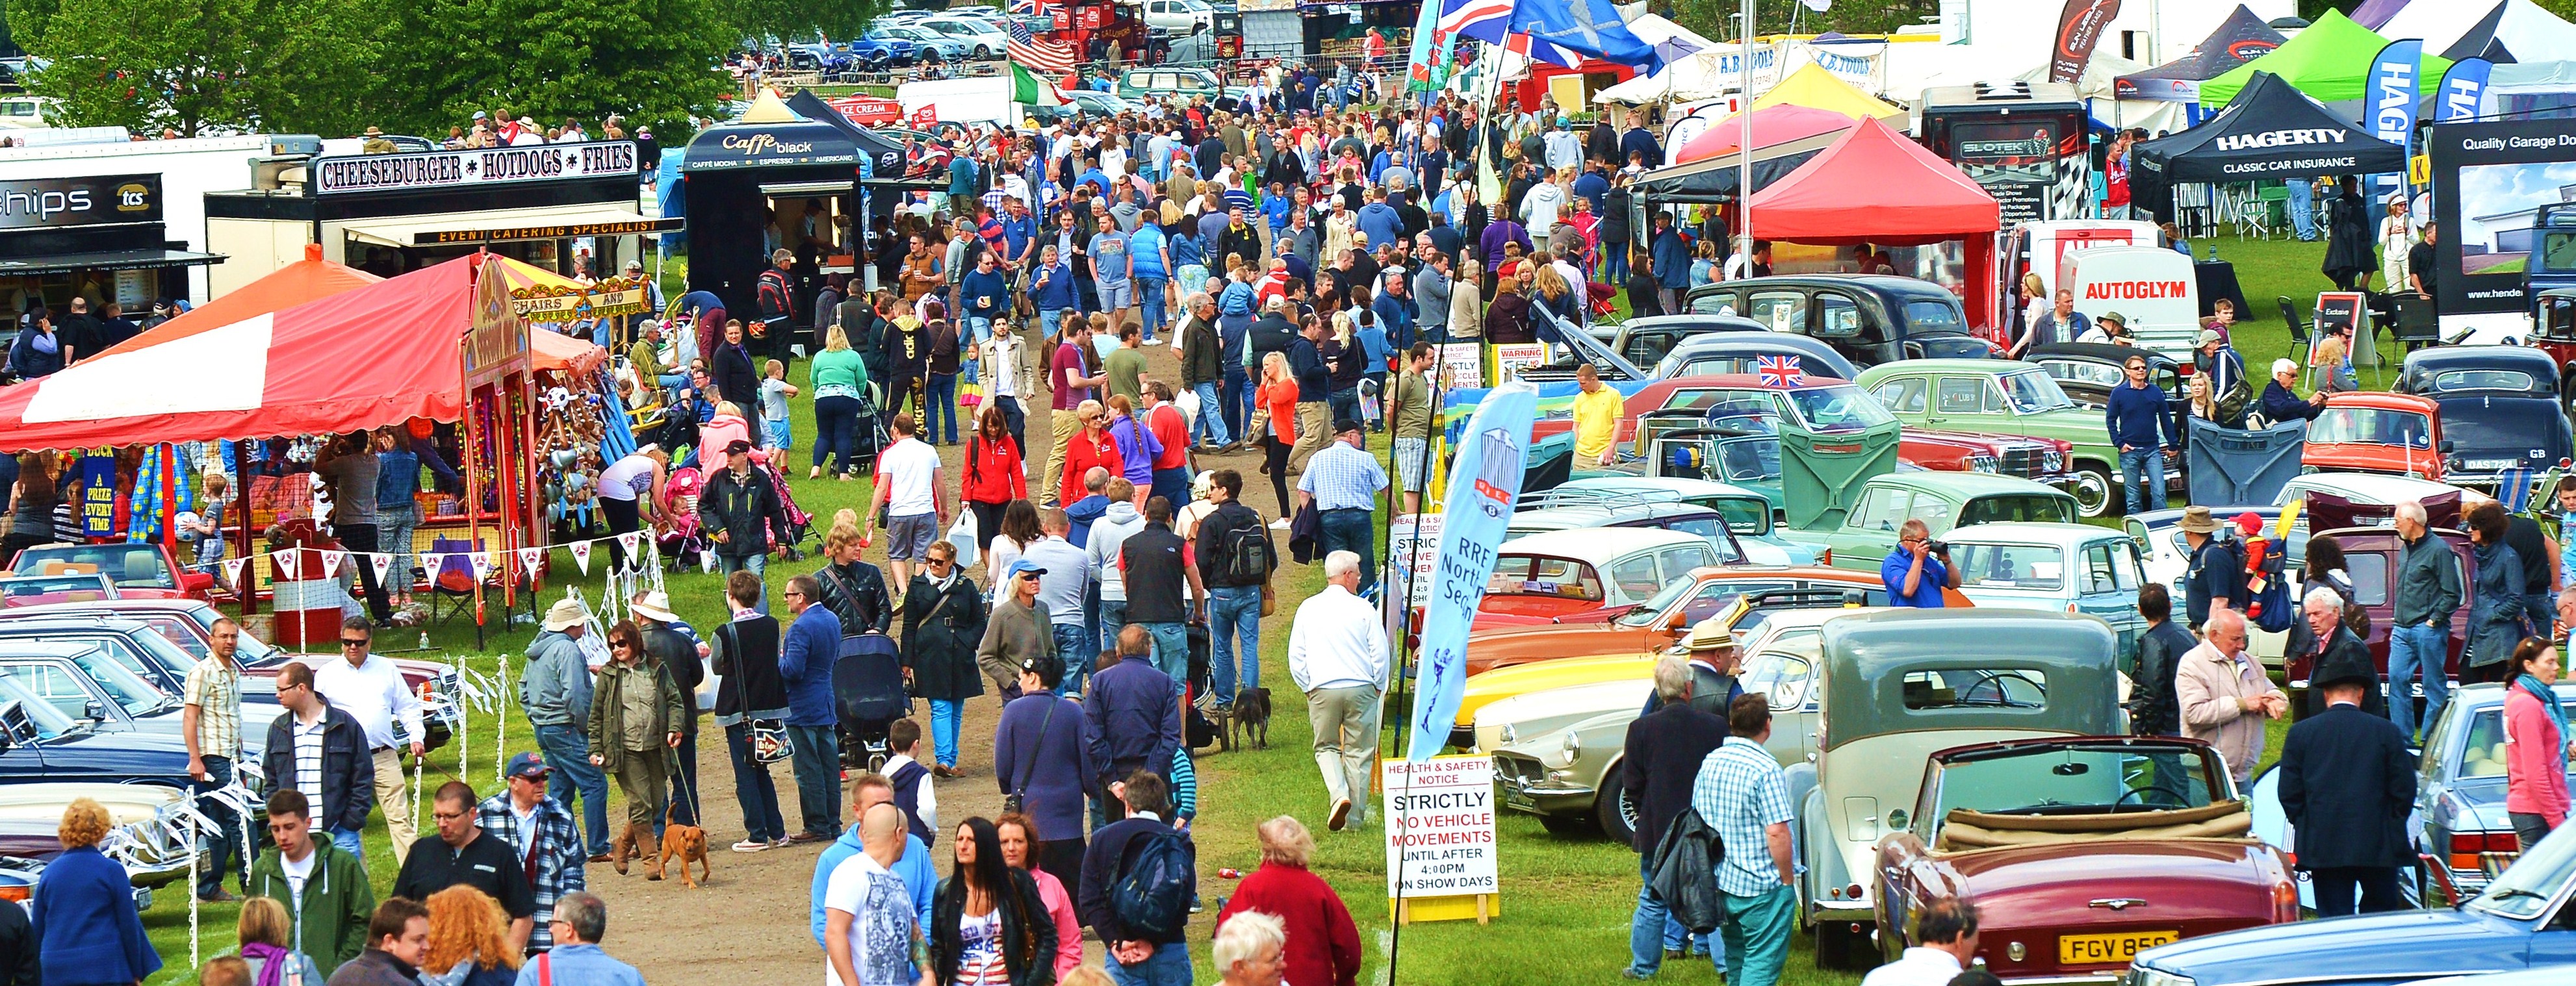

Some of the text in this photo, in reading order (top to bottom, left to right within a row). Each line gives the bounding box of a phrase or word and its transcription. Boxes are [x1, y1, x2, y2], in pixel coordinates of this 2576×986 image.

[2080, 0, 2104, 31] LEISUR
[840, 104, 886, 114] ICE CREAM
[777, 141, 812, 153] black
[2216, 129, 2347, 151] HAGERTY
[2462, 137, 2506, 151] Quality
[2509, 135, 2557, 151] Garage
[1964, 142, 2024, 153] SLOTEK
[321, 144, 633, 189] CHEESEBURGER HOTDOGS FRIES
[2223, 157, 2356, 173] CLASSIC CAR INSURANCE
[2415, 158, 2425, 181] K
[0, 189, 92, 220] hips
[122, 190, 144, 207] tcs
[440, 220, 656, 242] EVENT CATERING SPECIALIST
[2085, 281, 2186, 299] AUTOGLYM
[602, 292, 624, 305] AND
[2325, 307, 2350, 316] Exclusive
[1501, 349, 1542, 357] WARNING
[2529, 449, 2546, 459] GB
[95, 474, 103, 487] A
[87, 488, 112, 501] PRIZE
[84, 503, 114, 517] EVERY
[89, 518, 110, 531] TIME
[1398, 538, 1437, 550] STRIC
[1389, 761, 1488, 774] HEALTH & SAFETY
[1419, 774, 1459, 785] NOTICE
[1394, 792, 1486, 811] STRICTLY
[1397, 813, 1491, 829] NO VEHICLE
[1392, 830, 1491, 847] MOVEMENTS
[1402, 848, 1483, 861] UNTIL AFTER
[1421, 863, 1465, 874] 4:00PM
[1395, 876, 1493, 890] ON SHOW DAYS
[2072, 939, 2116, 959] FGV
